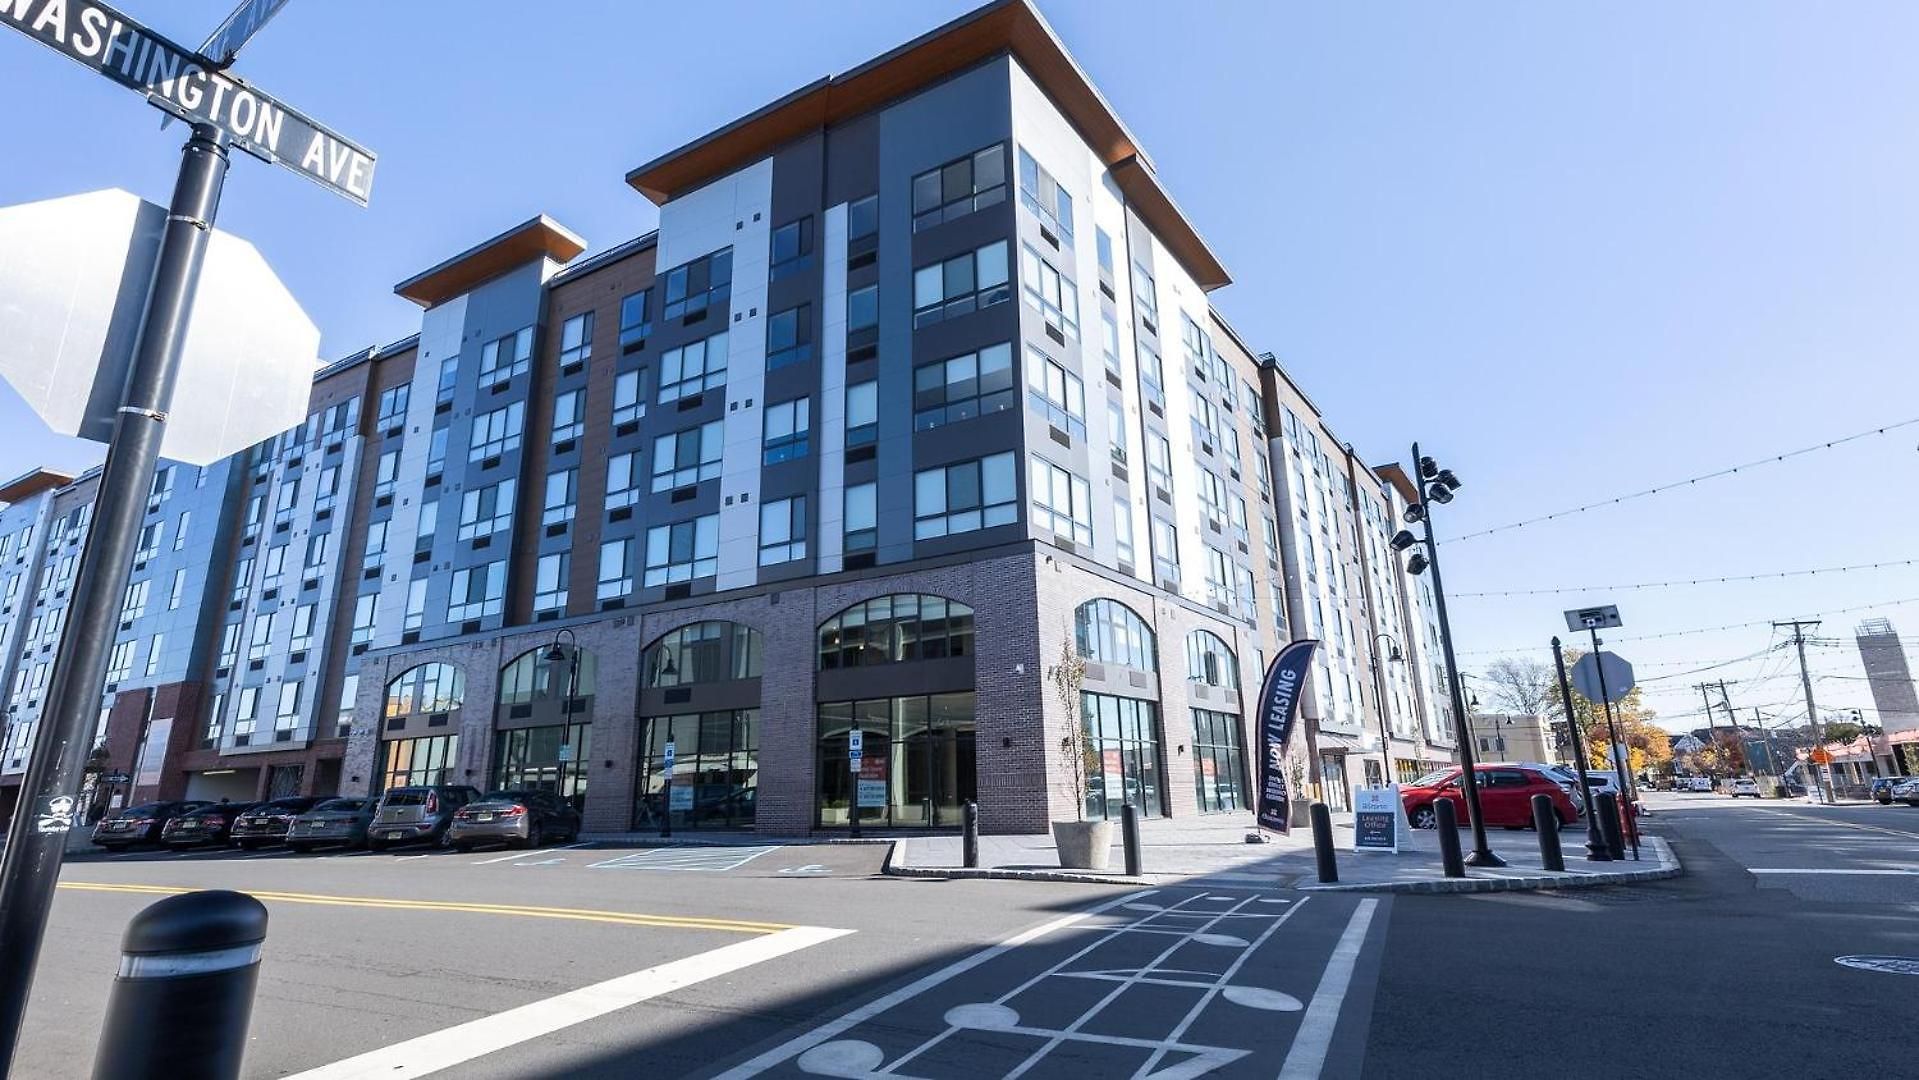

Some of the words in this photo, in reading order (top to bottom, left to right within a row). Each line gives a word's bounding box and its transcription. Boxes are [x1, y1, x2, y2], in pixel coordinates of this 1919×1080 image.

[303, 134, 372, 193] AVE
[1268, 669, 1296, 730] LEASING
[1268, 733, 1282, 770] NOW
